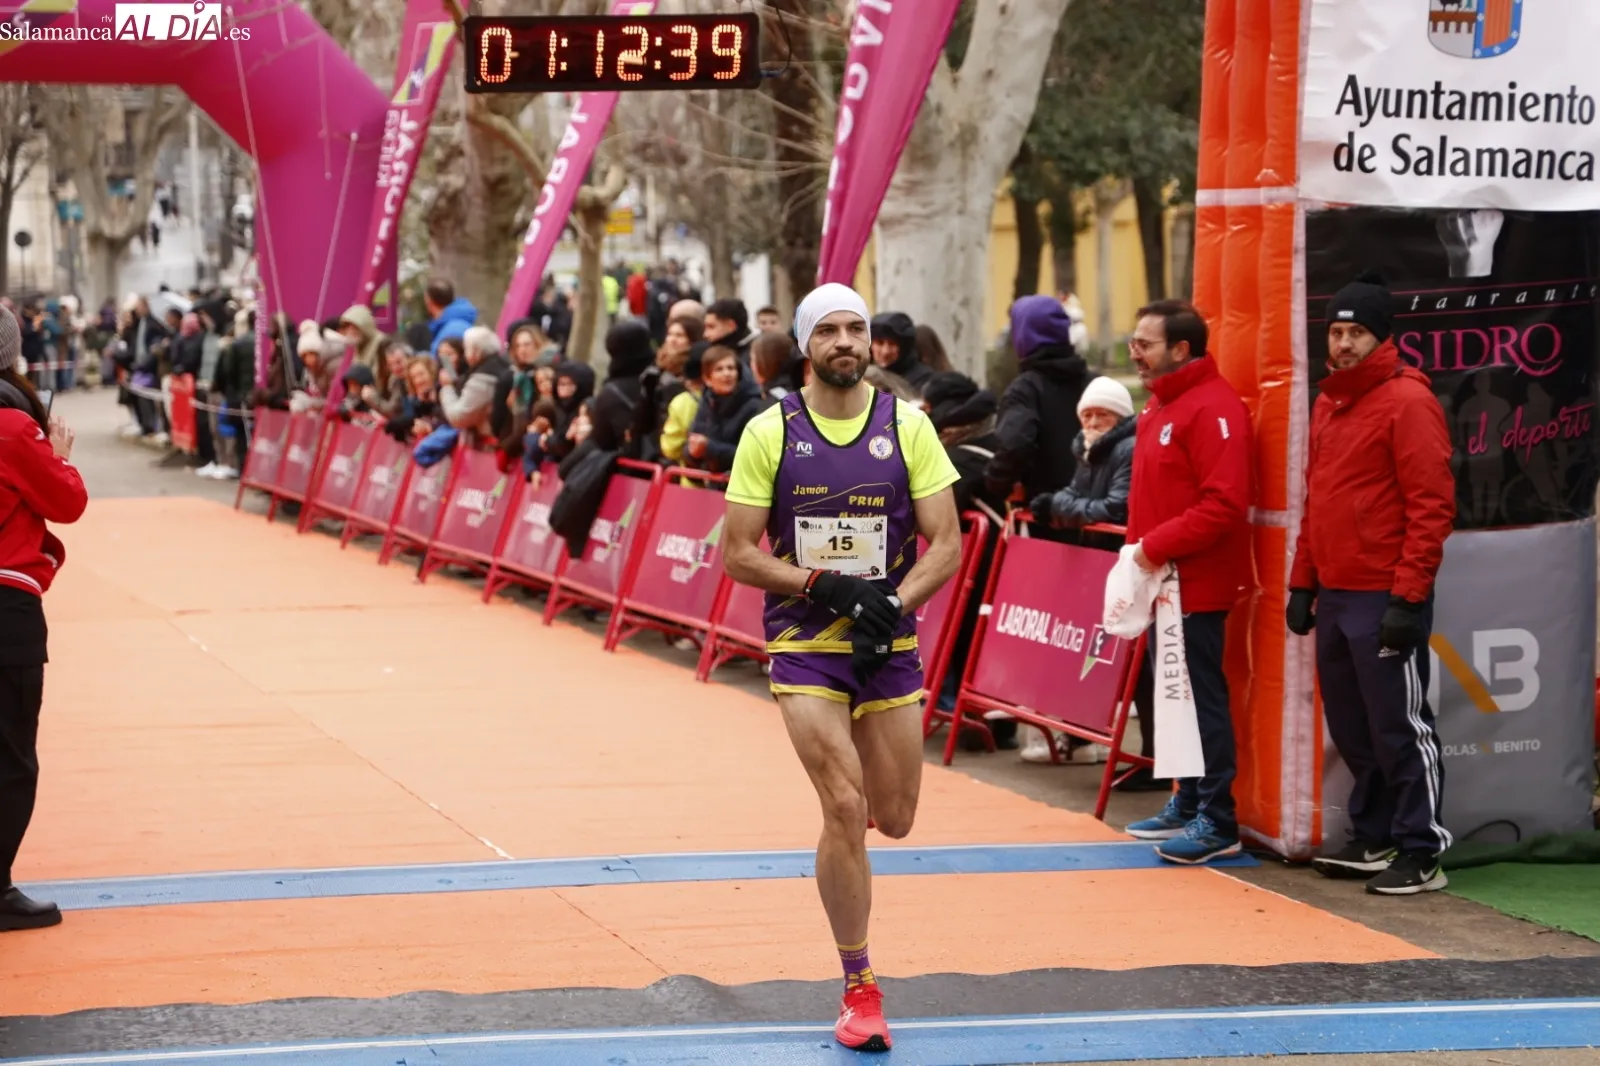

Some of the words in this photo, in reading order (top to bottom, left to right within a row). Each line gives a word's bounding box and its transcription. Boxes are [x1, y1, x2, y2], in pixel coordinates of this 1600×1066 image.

[1335, 74, 1596, 128] Ayuntamiento
[1333, 131, 1377, 173] de
[1390, 133, 1595, 182] Salamanca
[1410, 284, 1598, 311] taurante
[1399, 323, 1563, 376] SIDRO
[793, 484, 828, 495] Jamón
[848, 495, 885, 507] PRIM
[828, 535, 853, 551] 15
[996, 601, 1052, 645] LABORAL
[1049, 616, 1086, 654] kutxa
[1164, 623, 1181, 701] MEDIA
[1494, 738, 1542, 754] BENITO
